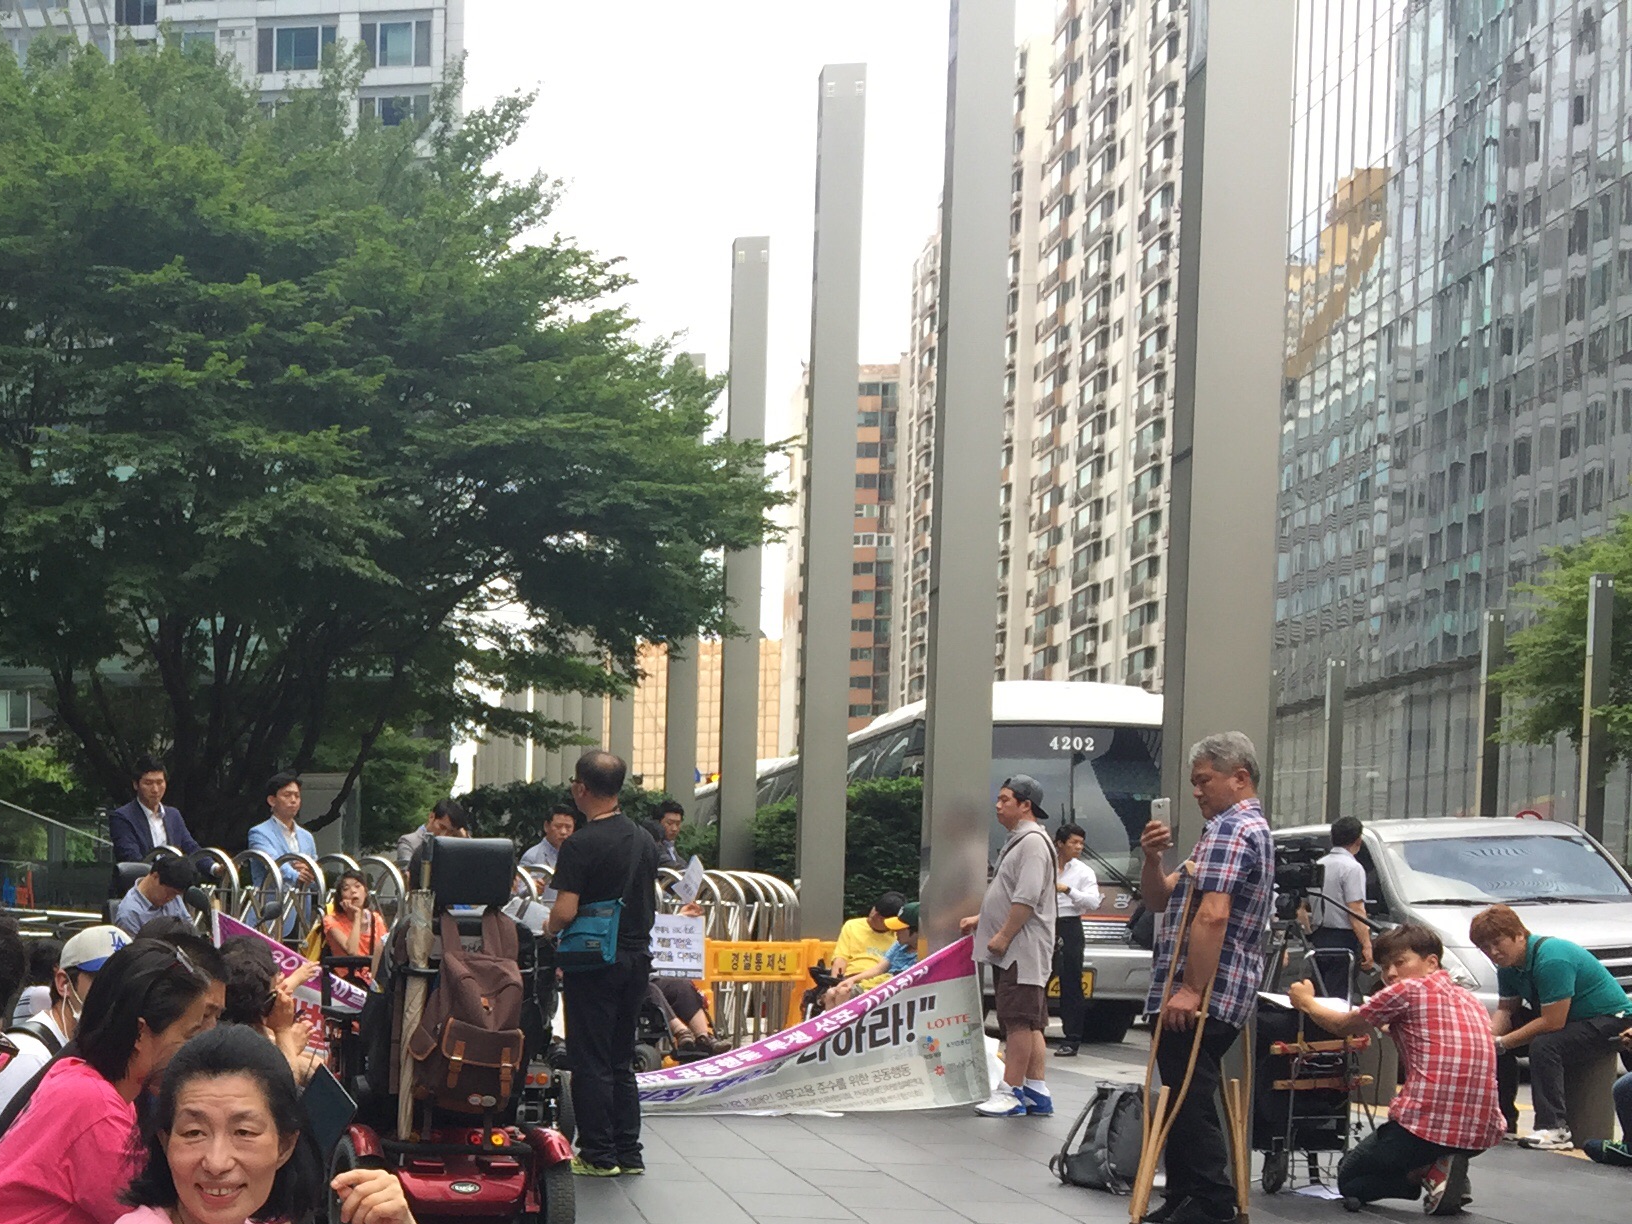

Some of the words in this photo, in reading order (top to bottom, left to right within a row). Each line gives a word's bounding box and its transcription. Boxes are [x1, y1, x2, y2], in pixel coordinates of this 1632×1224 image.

[1049, 736, 1095, 751] 4202
[731, 952, 786, 971] 경찰통제선
[815, 1007, 859, 1033] 선포
[927, 1013, 971, 1030] LOTTE
